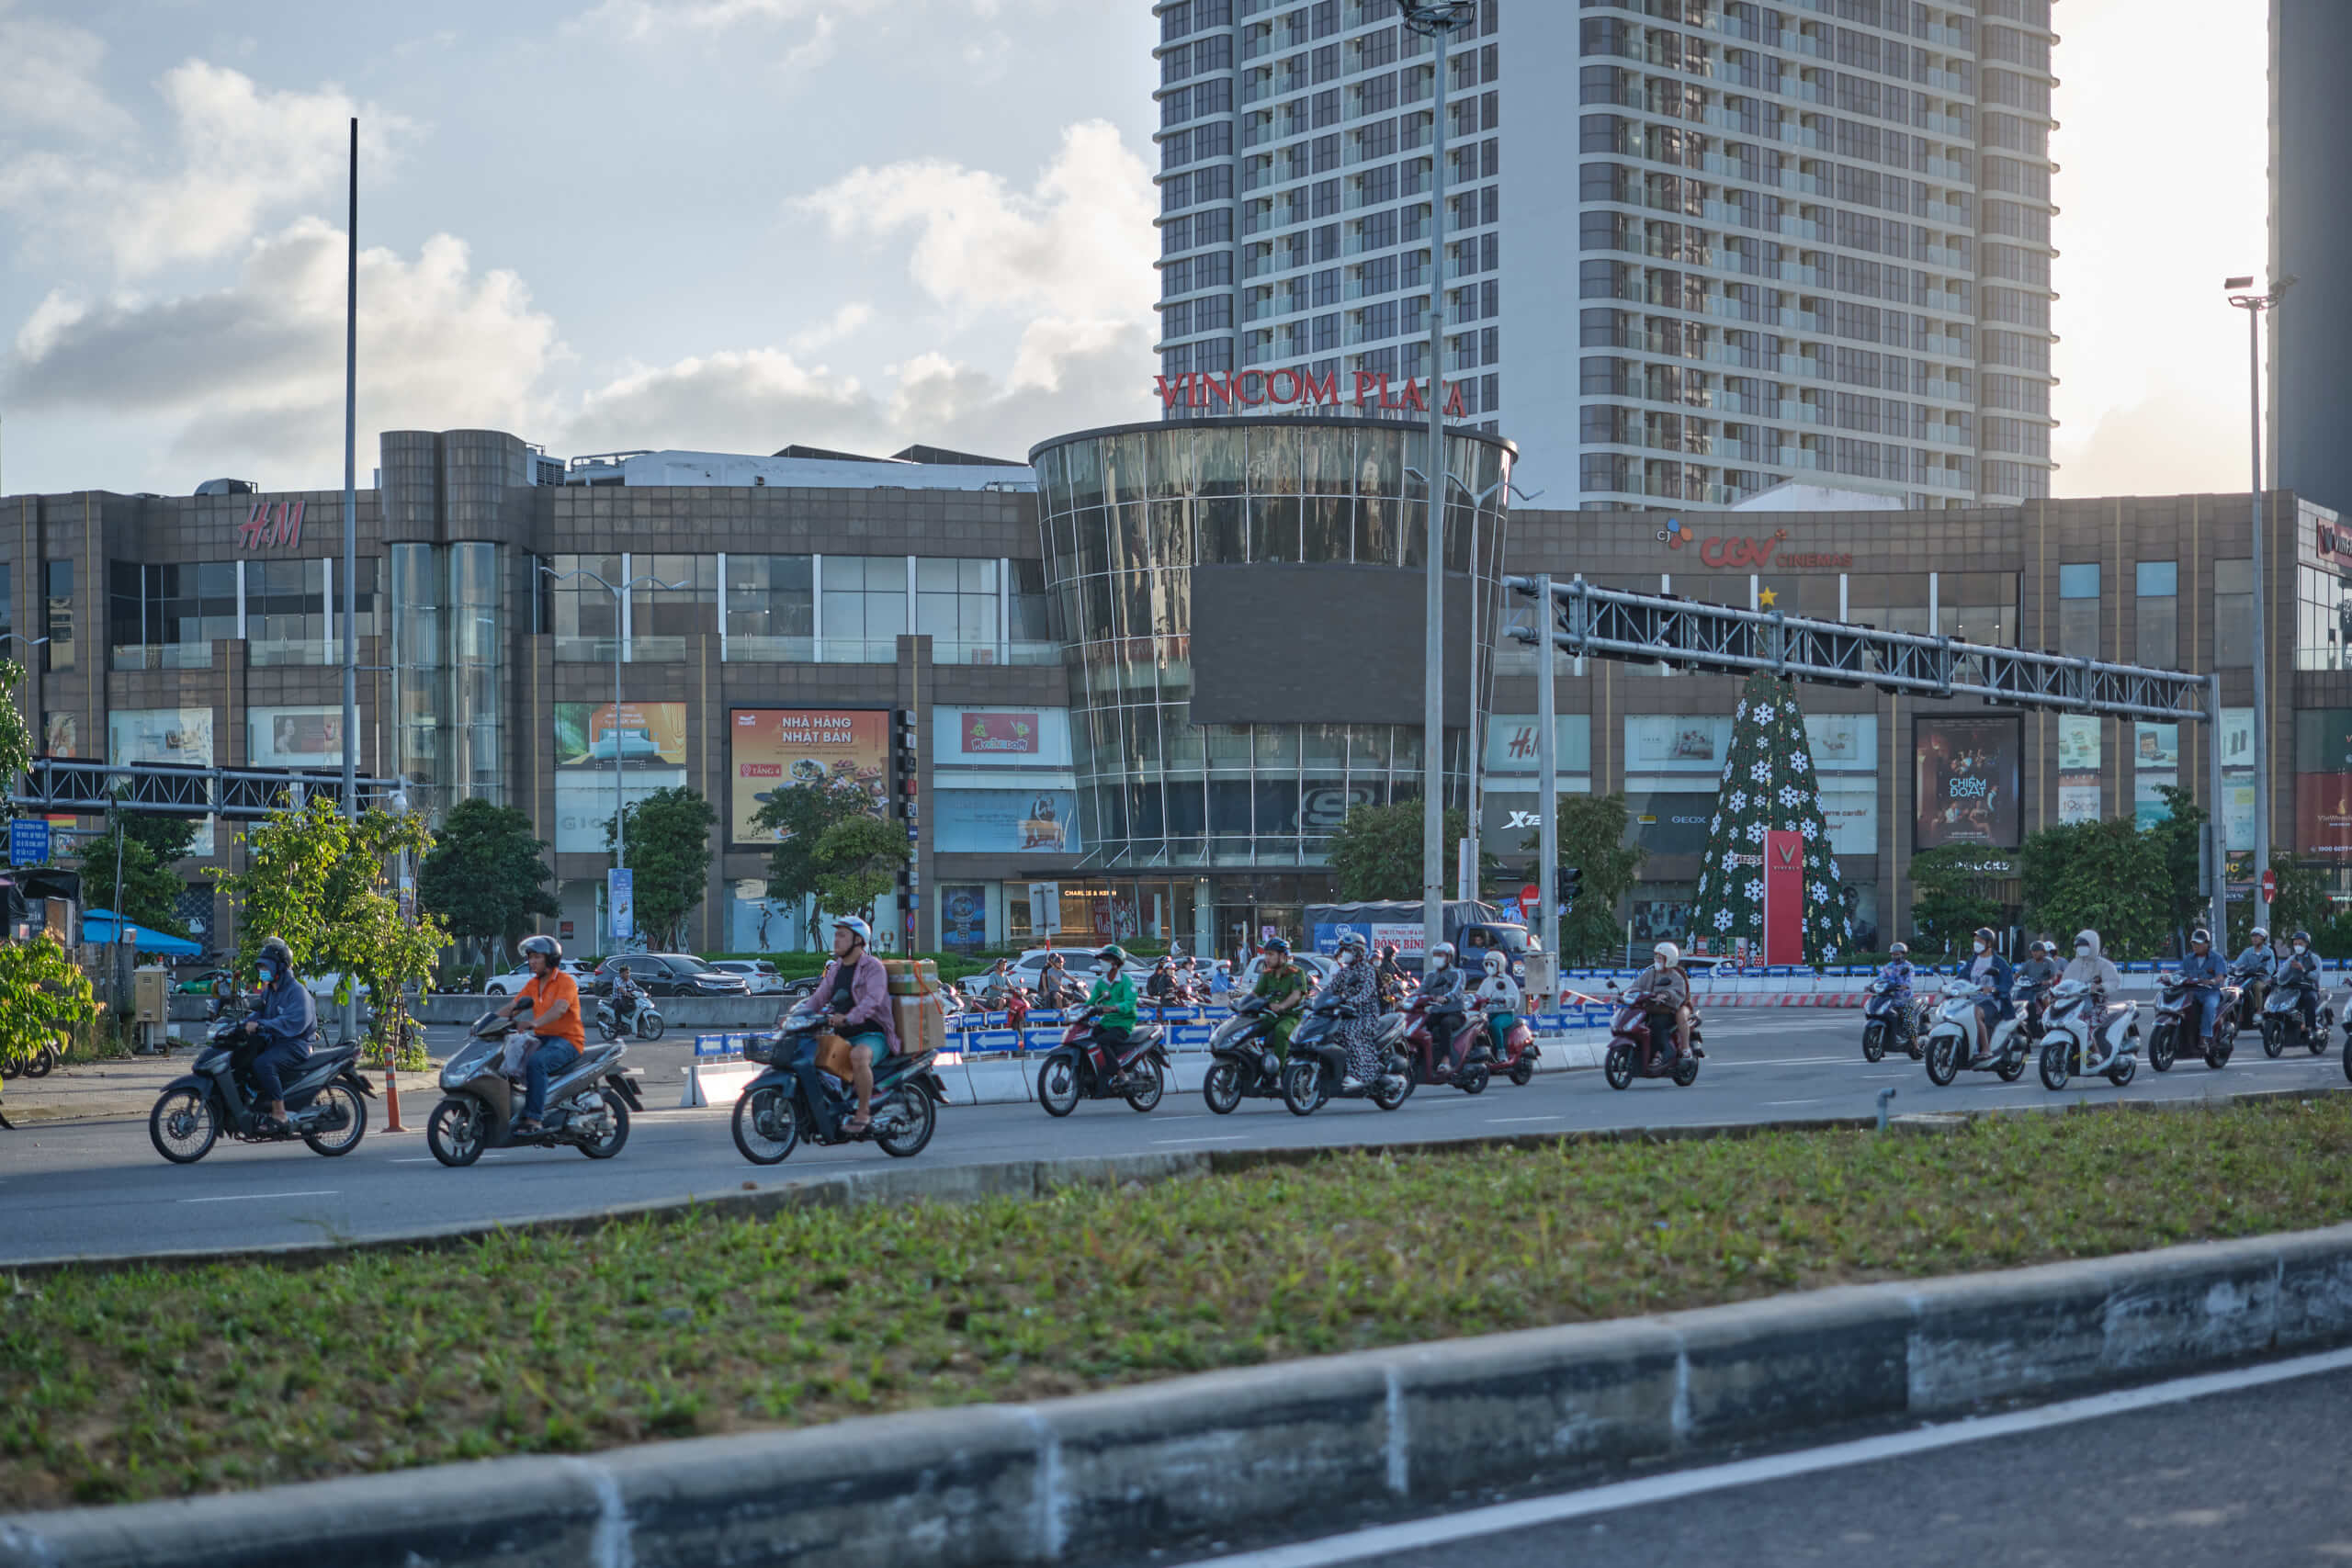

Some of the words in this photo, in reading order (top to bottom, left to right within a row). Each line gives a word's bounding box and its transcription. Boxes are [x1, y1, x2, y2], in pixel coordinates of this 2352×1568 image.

[1153, 368, 1342, 409] VINCOM
[1352, 370, 1468, 418] PLAA
[239, 500, 307, 550] H&M
[1701, 536, 1776, 567] CGV
[1776, 553, 1853, 567] CINEMAS
[782, 715, 810, 728] NHÀ
[813, 715, 853, 728] HÀNG
[1500, 810, 1541, 829] XTE
[1671, 816, 1706, 824] GEOX
